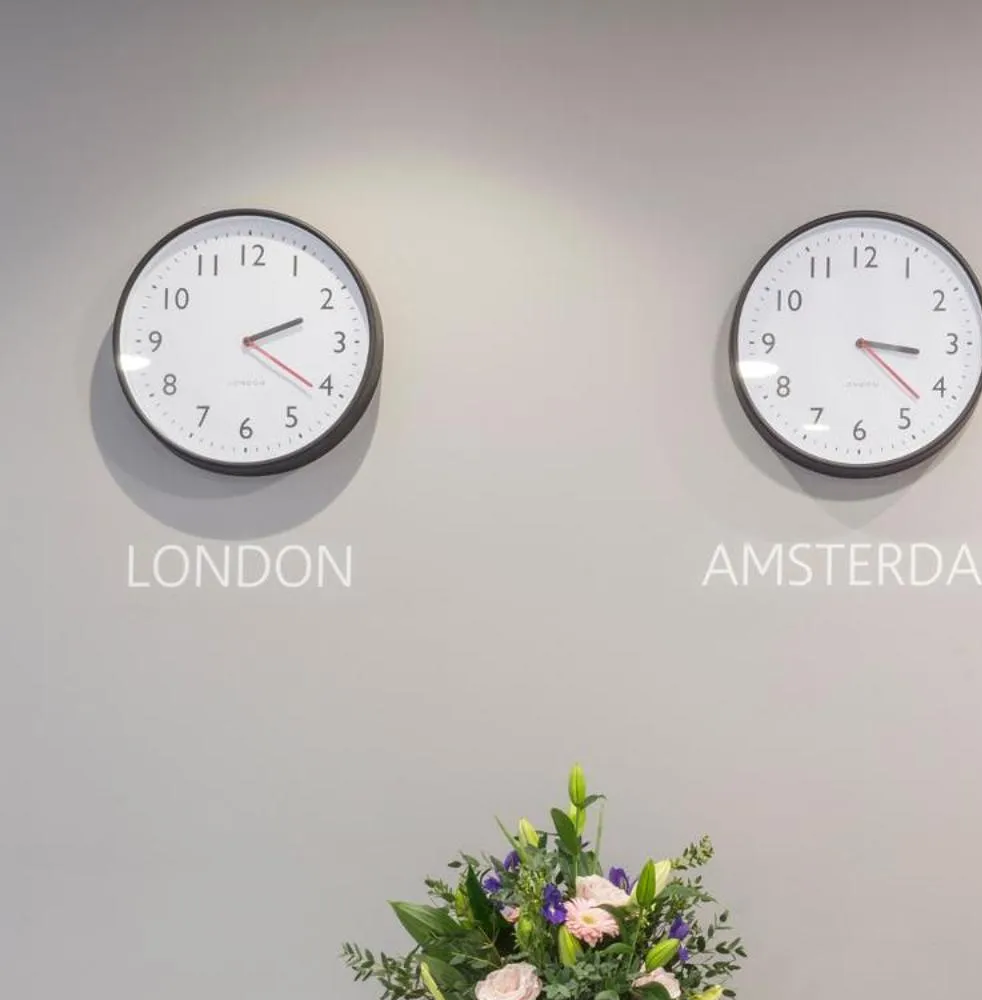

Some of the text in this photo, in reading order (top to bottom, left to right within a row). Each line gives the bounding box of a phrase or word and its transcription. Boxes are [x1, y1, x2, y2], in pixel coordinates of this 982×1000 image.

[198, 255, 218, 276] 11
[241, 244, 265, 266] 12
[854, 246, 878, 268] 12
[811, 257, 831, 278] 11
[165, 288, 189, 309] 10
[321, 288, 334, 309] 2
[778, 290, 802, 311] 10
[933, 290, 946, 311] 2
[149, 331, 162, 352] 9
[334, 331, 345, 353] 3
[762, 333, 775, 354] 9
[947, 333, 958, 354] 3
[163, 374, 176, 395] 8
[319, 375, 333, 396] 4
[777, 376, 790, 397] 8
[932, 376, 946, 397] 4
[197, 406, 210, 427] 7
[285, 406, 297, 428] 5
[810, 407, 824, 425] 7
[898, 408, 911, 429] 5
[240, 418, 253, 439] 6
[853, 420, 866, 440] 6
[128, 545, 352, 588] LONDON
